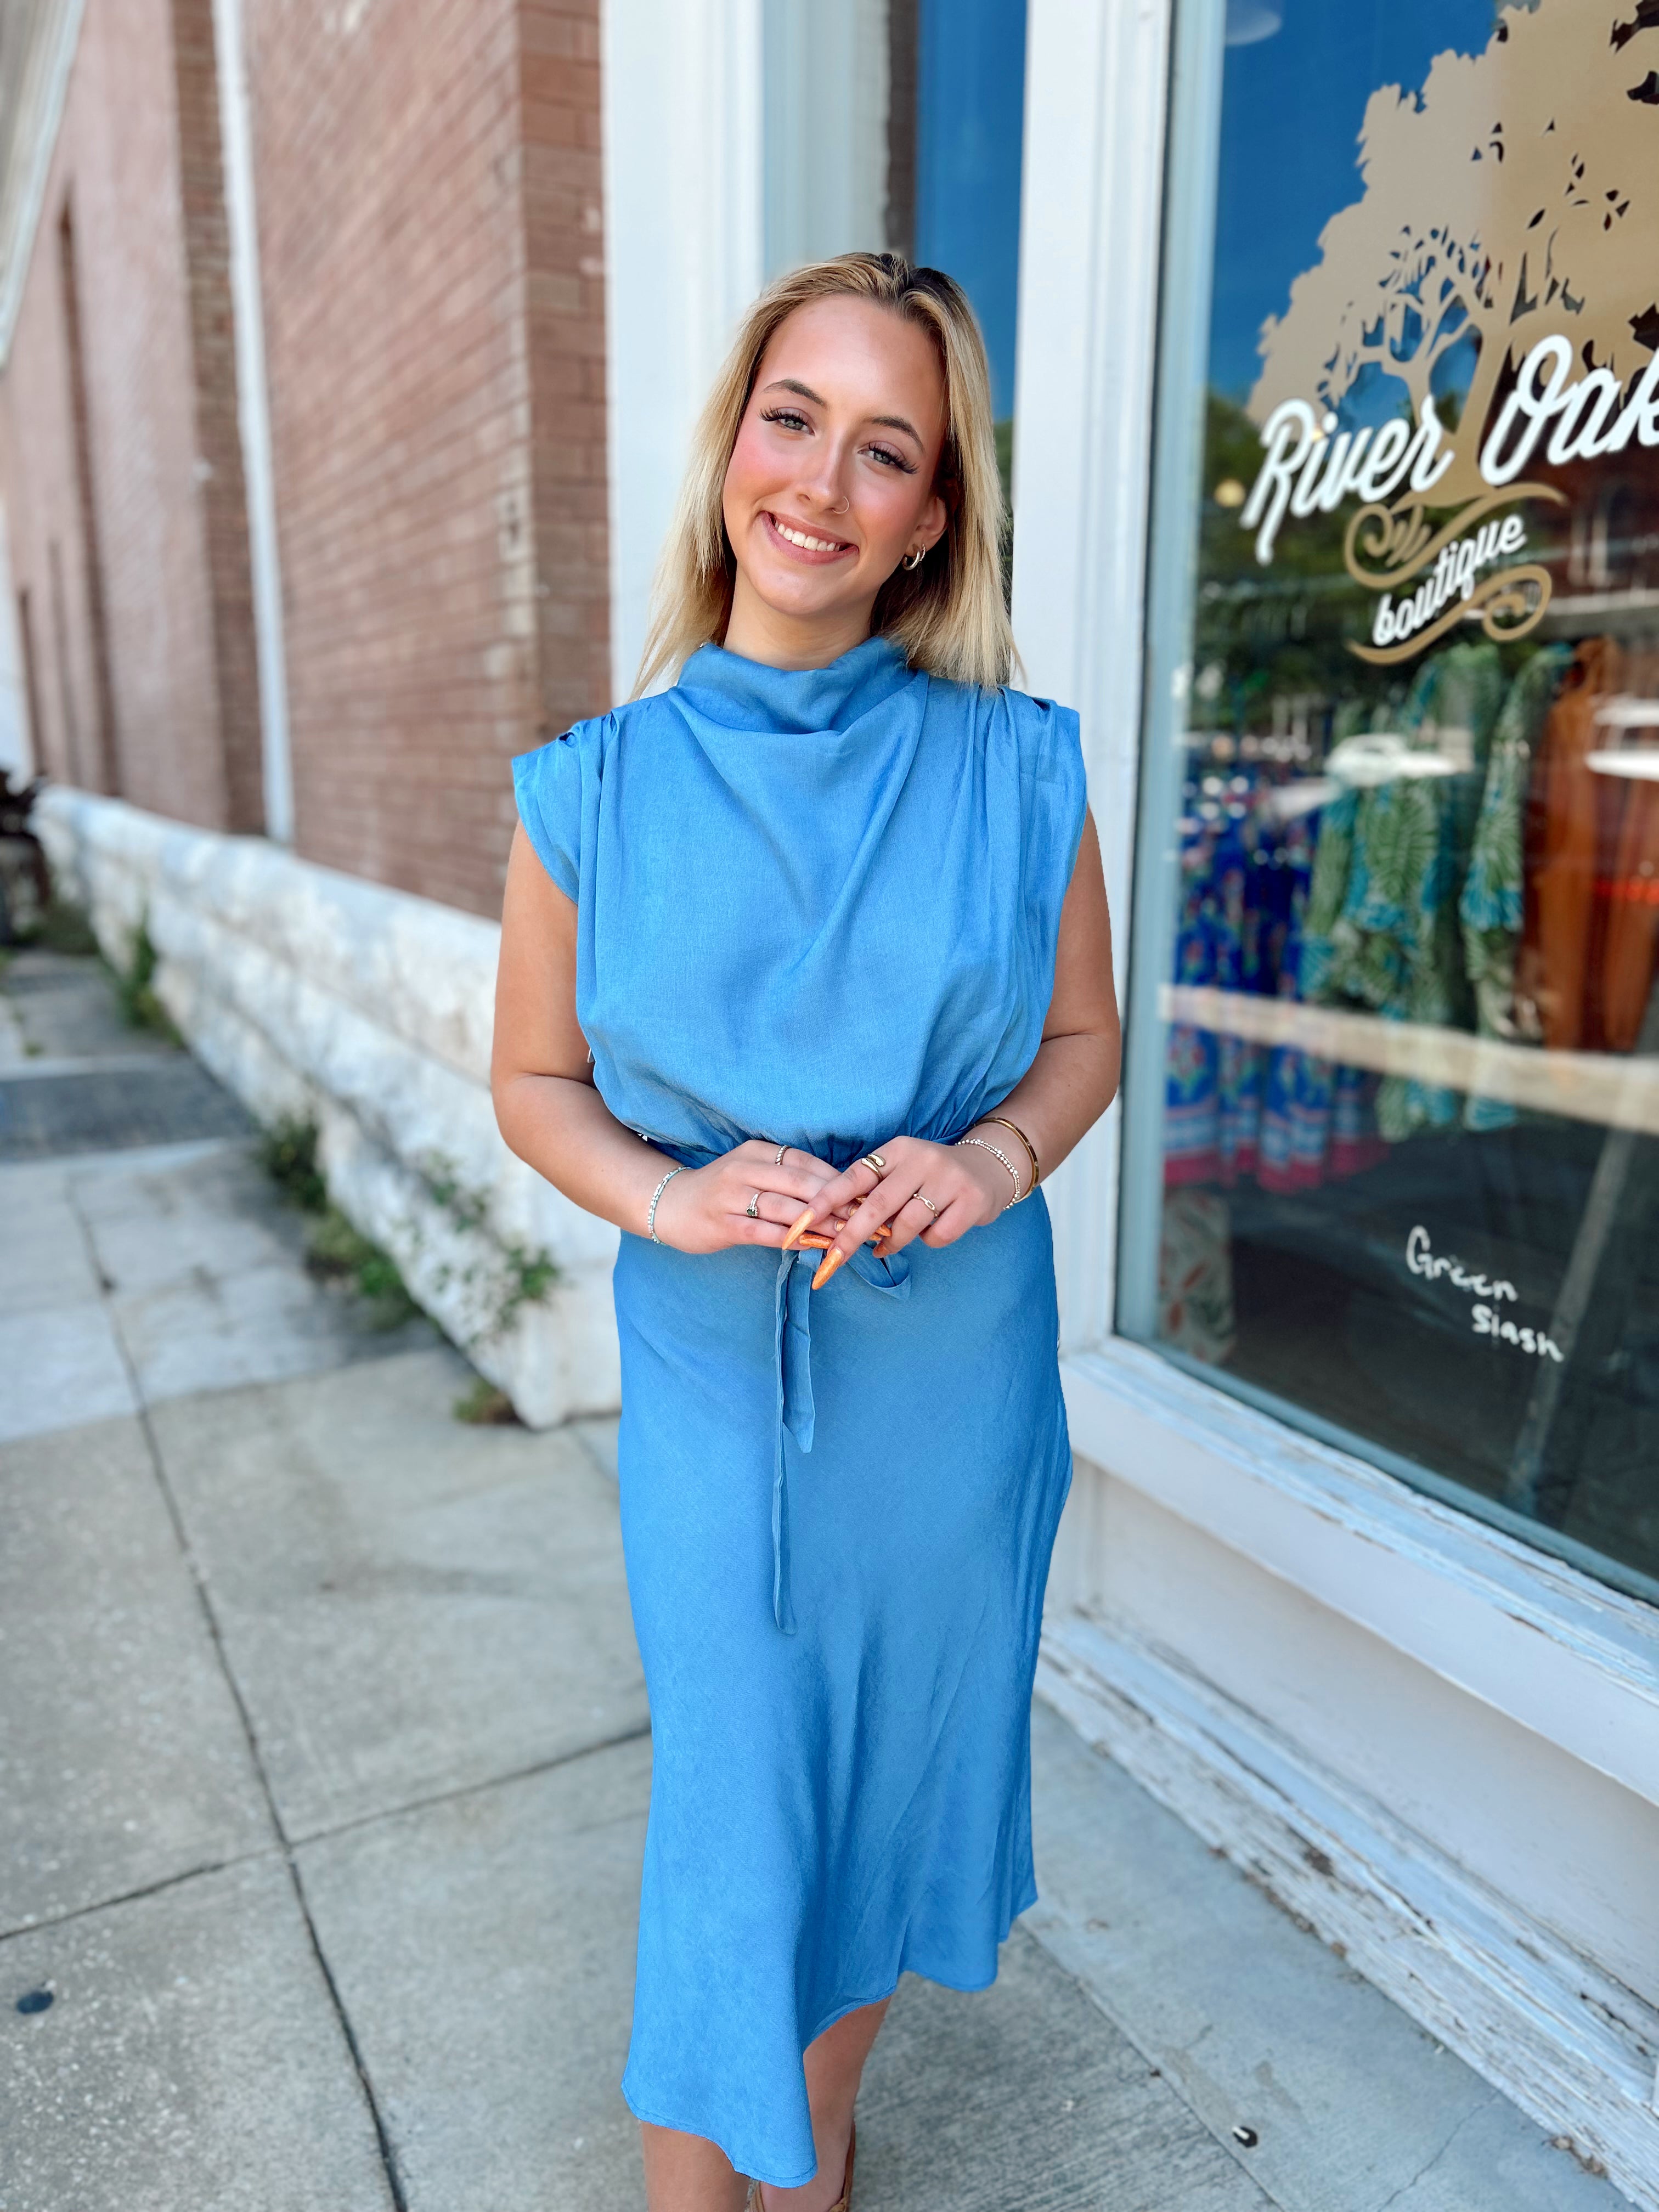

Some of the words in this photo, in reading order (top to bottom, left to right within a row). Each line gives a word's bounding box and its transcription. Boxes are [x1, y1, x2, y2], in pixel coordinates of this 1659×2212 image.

[1240, 394, 1455, 564] River
[1373, 515, 1526, 646] boutique
[1406, 1225, 1519, 1302] Green
